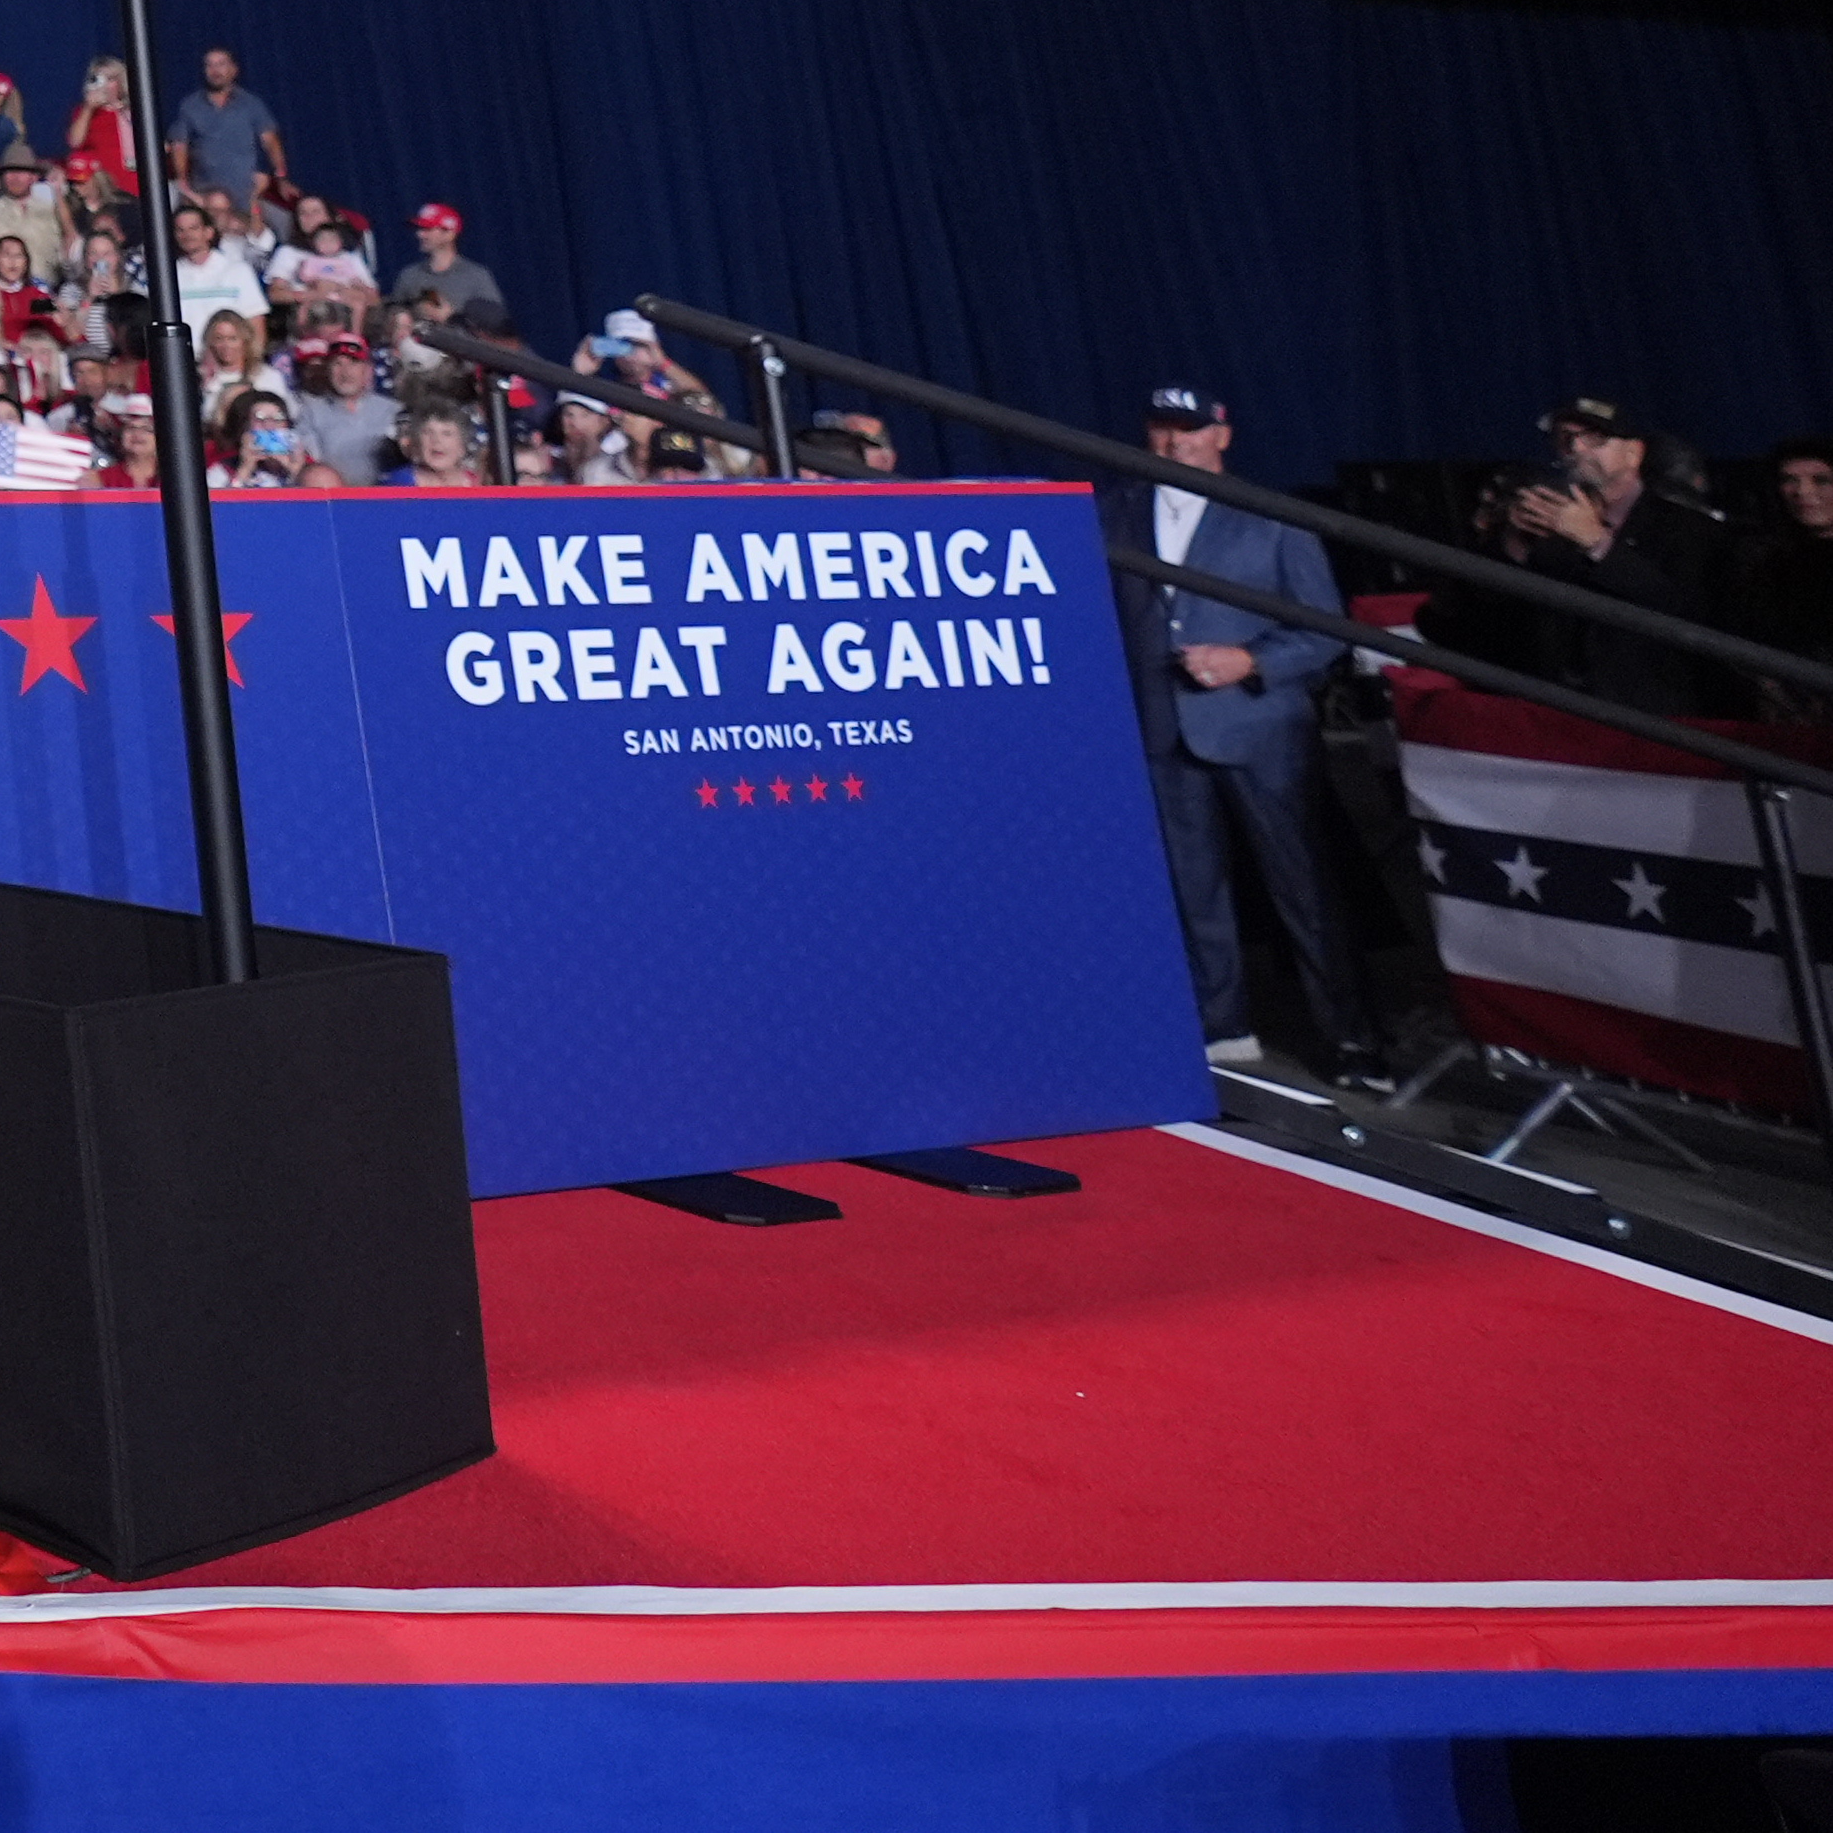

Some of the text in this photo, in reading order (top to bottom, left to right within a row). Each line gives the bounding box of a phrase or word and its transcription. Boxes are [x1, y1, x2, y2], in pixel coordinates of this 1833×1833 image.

[399, 528, 1057, 609] MAKE AMERICA
[445, 617, 1052, 706] GREAT AGAIN!
[622, 719, 914, 756] SAN ANTONIO, TEXAS
